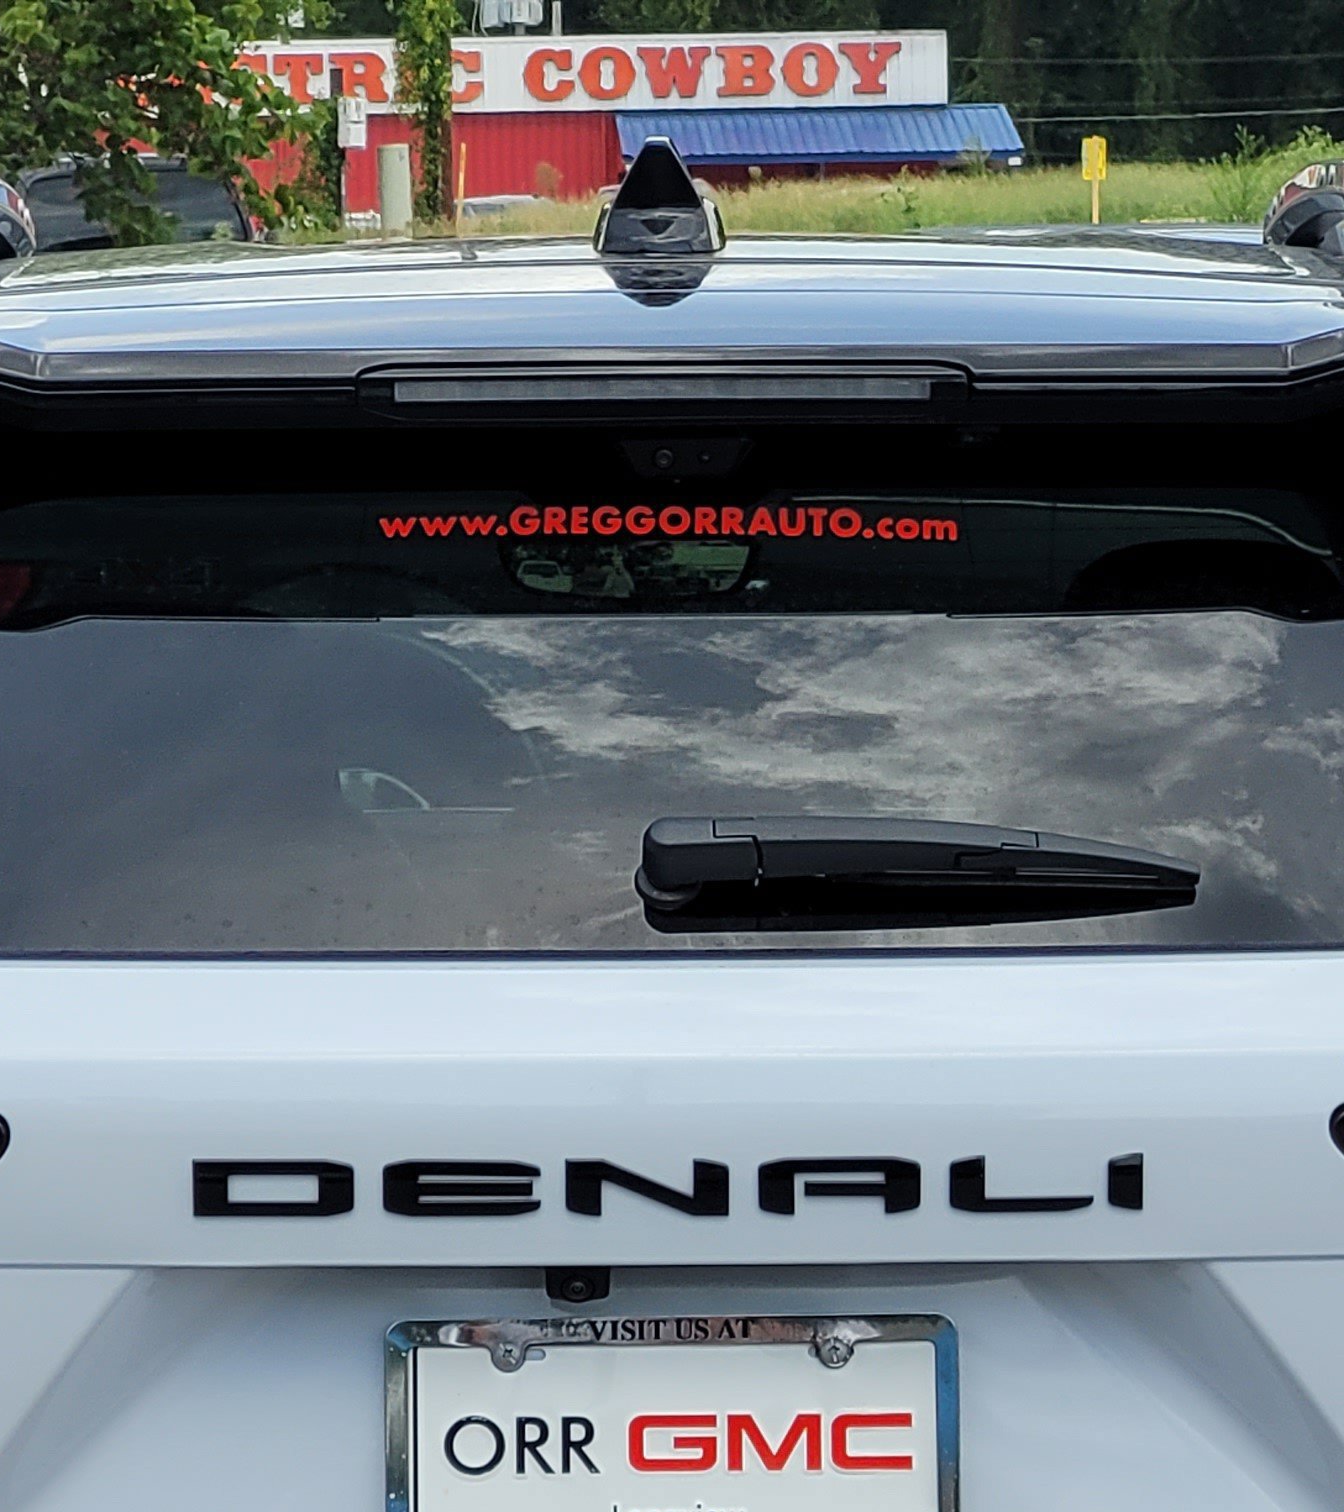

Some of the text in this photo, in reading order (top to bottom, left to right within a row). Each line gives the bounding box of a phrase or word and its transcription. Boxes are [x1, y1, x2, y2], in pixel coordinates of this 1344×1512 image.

[523, 42, 902, 101] COWBOY
[379, 505, 958, 541] www.GREGGORRAUTO.com
[192, 1152, 1145, 1217] DENALI
[589, 1318, 755, 1341] VISIT US AT
[444, 1412, 914, 1475] ORR GMC
